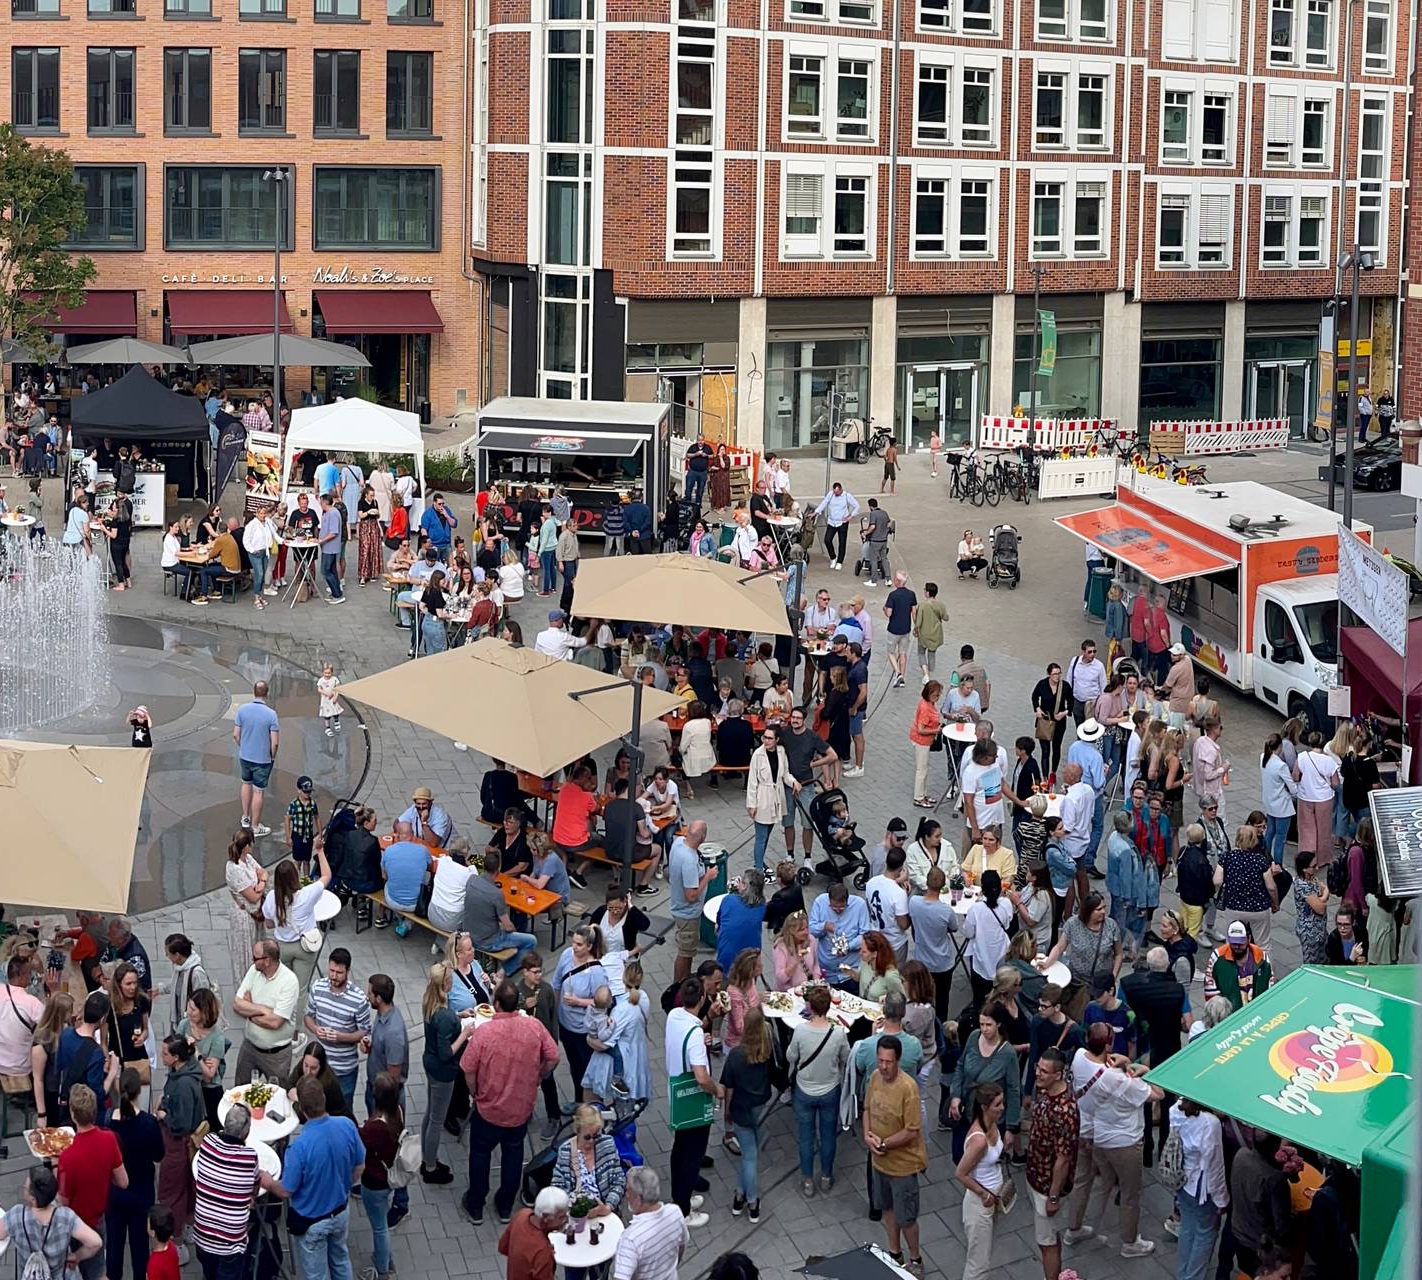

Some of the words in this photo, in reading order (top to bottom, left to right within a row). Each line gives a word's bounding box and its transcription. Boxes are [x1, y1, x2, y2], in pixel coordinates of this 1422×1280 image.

[212, 274, 244, 283] DELI
[257, 275, 288, 284] BAR
[312, 265, 359, 284] Noah's
[361, 273, 368, 284] &
[403, 276, 435, 284] PLACE
[1239, 1036, 1255, 1048] LA
[1213, 1043, 1243, 1065] CARTE
